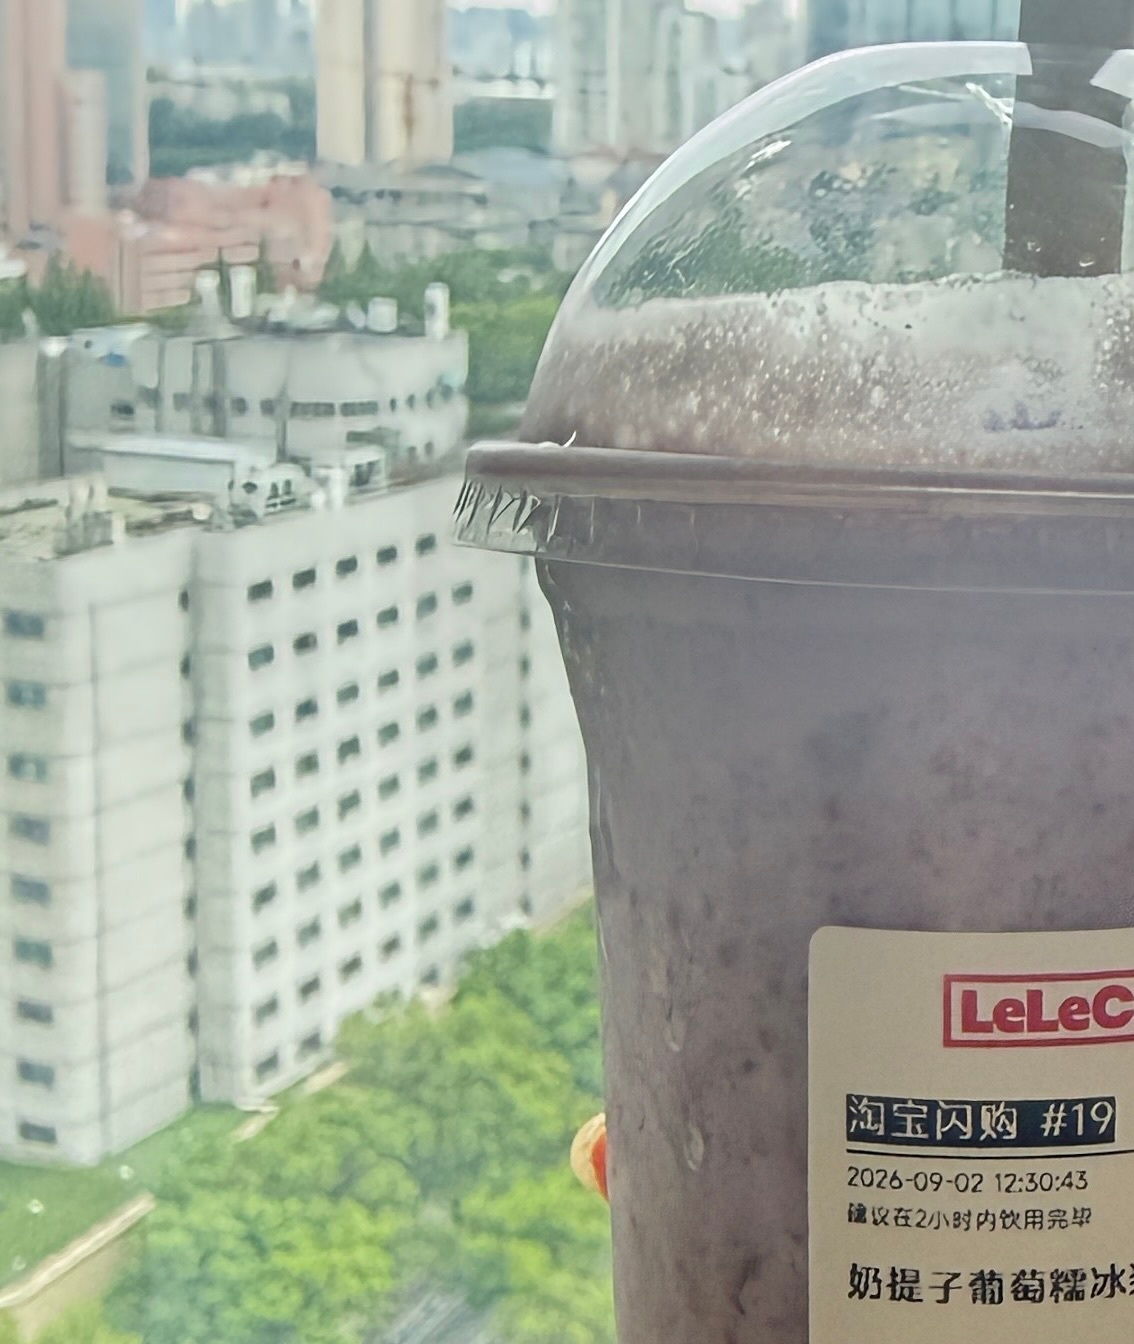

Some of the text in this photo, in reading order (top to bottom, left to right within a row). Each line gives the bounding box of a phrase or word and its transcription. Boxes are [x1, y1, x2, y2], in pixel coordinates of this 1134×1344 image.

[848, 1099, 1115, 1142] 淘宝闪购 #19
[847, 1166, 1089, 1194] 2026-09-02 12:30:43
[847, 1202, 1092, 1232] 建议在2小时内饮用完毕
